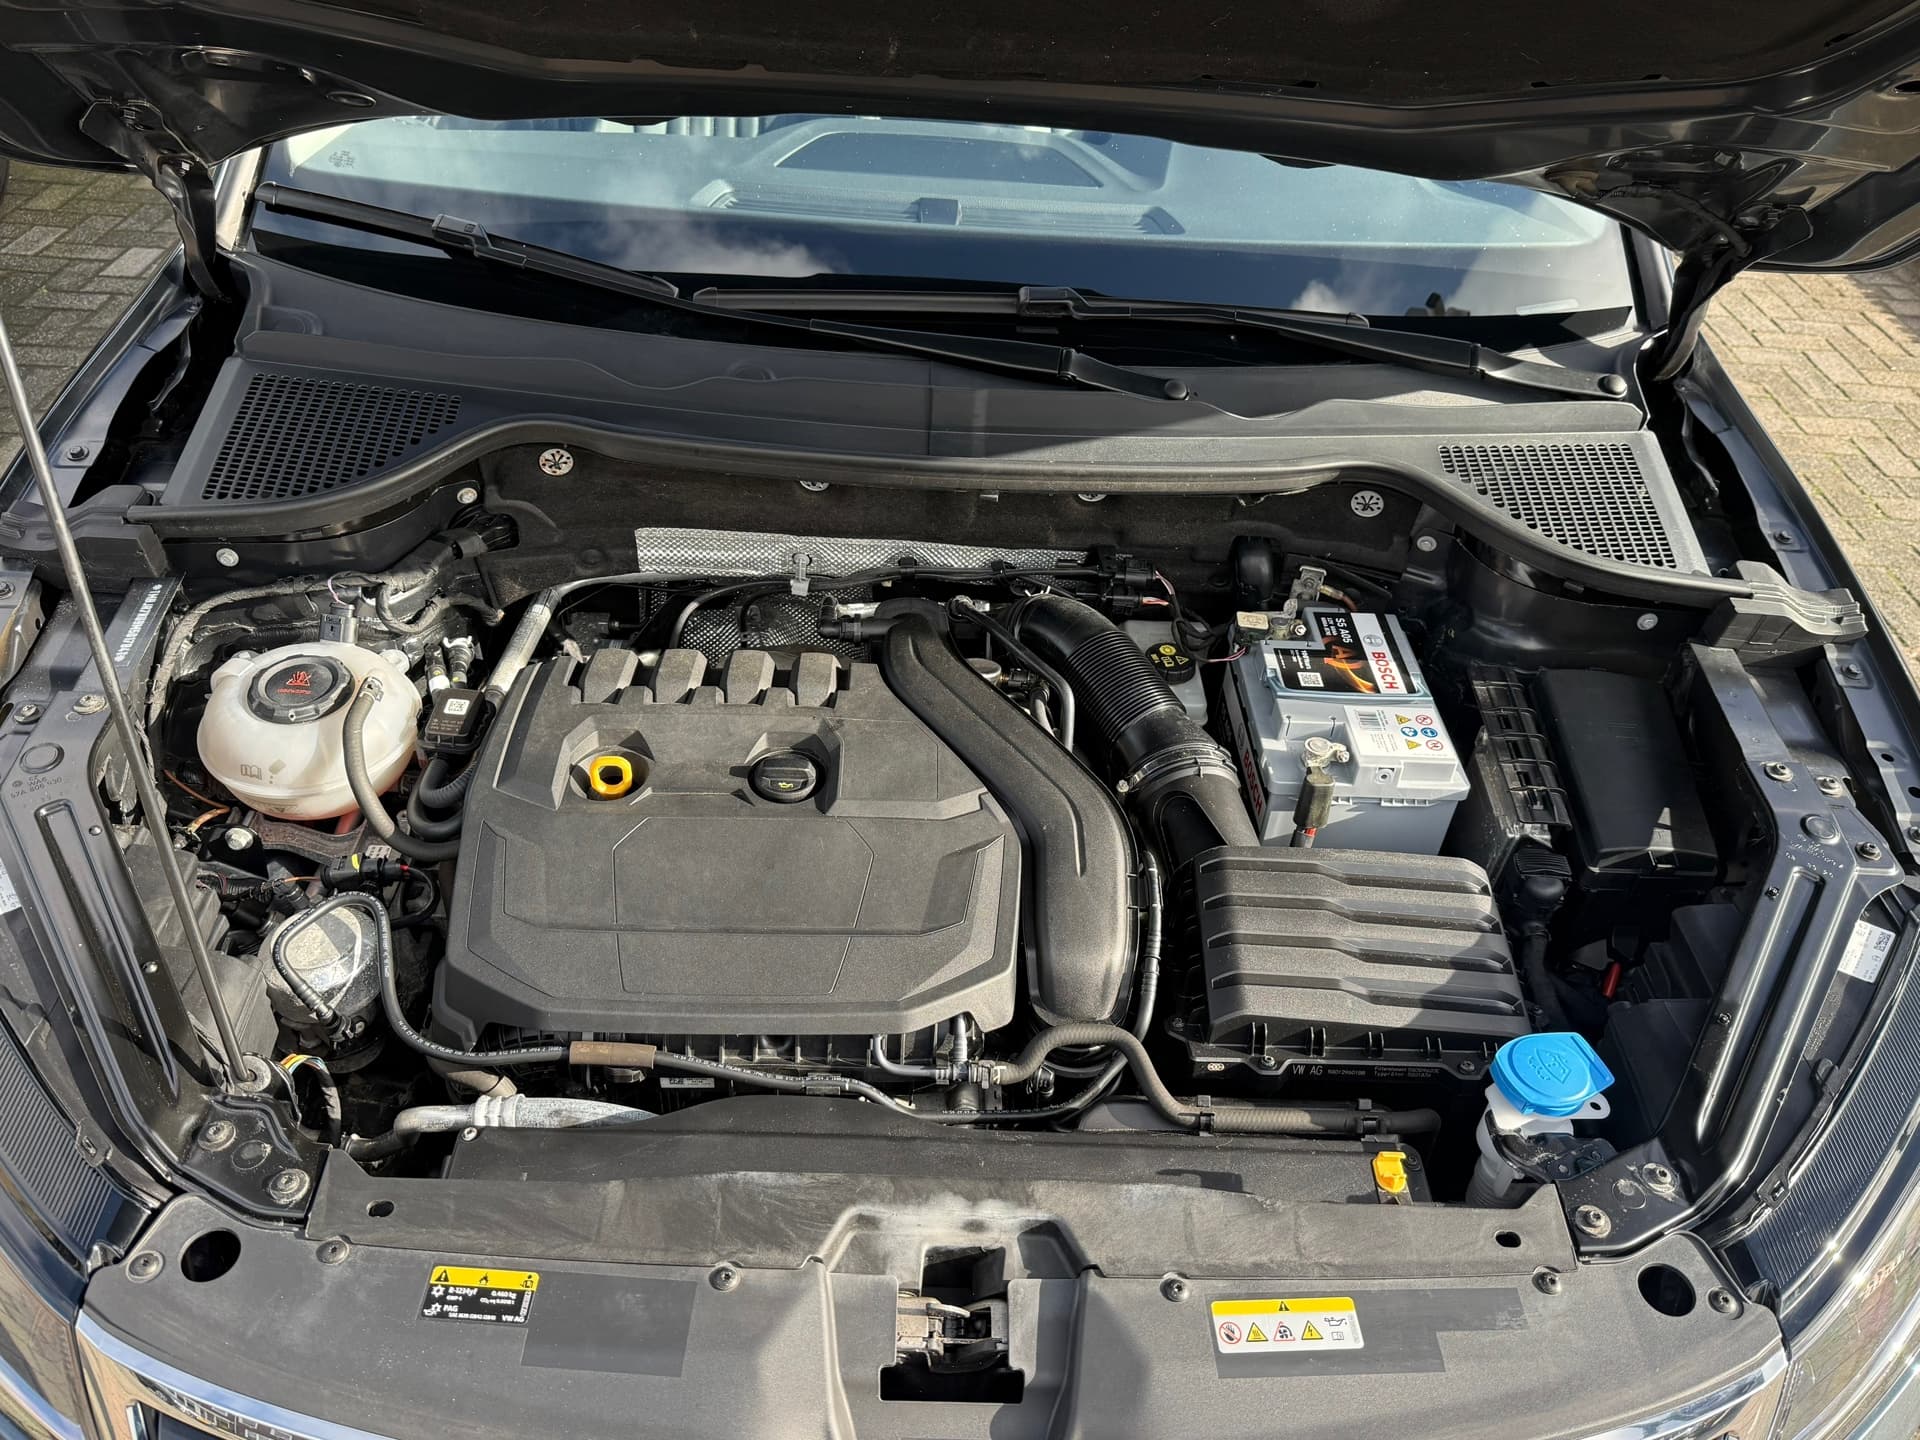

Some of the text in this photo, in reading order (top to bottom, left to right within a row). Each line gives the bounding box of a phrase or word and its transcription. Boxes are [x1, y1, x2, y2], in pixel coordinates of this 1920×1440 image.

[1335, 617, 1353, 643] S5 A05
[1371, 651, 1400, 689] BOSCH
[1243, 750, 1263, 817] BOSCH
[1292, 1065, 1305, 1074] VW
[1310, 1065, 1323, 1075] AG
